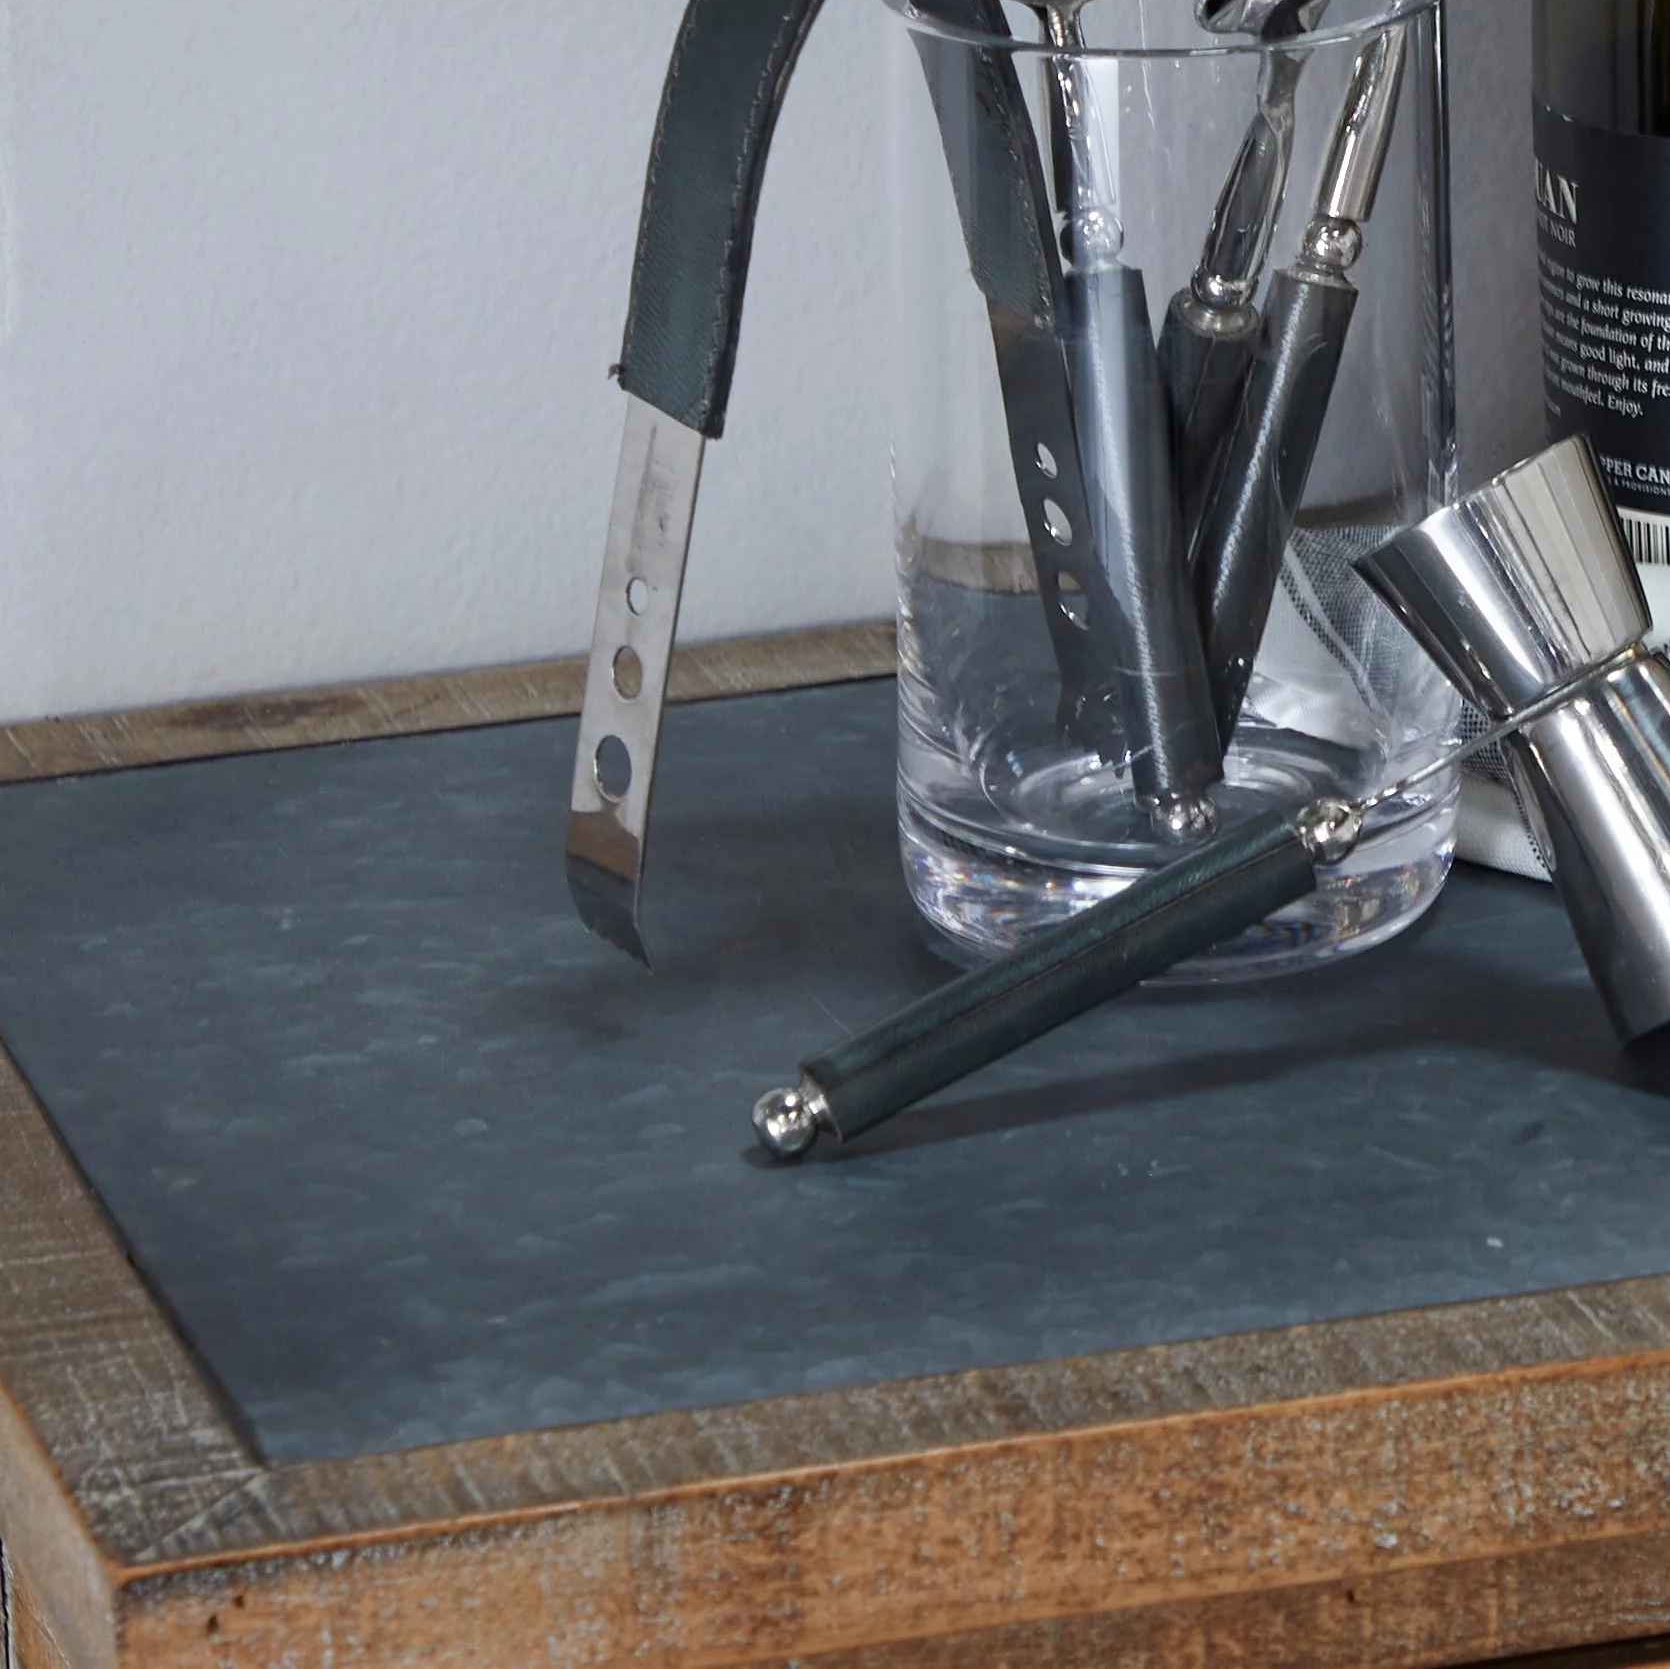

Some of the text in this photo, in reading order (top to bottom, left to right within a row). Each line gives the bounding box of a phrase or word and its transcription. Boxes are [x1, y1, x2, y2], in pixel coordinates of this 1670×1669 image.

[1549, 218, 1577, 248] NOIR
[1576, 273, 1601, 291] grow
[1602, 276, 1624, 299] this
[1582, 297, 1591, 312] a
[1591, 297, 1620, 320] short
[1580, 316, 1637, 347] foundation
[1640, 331, 1655, 354] of
[1579, 341, 1606, 361] good
[1608, 346, 1641, 371] light,
[1644, 355, 1670, 375] and
[1586, 364, 1630, 394] through
[1632, 376, 1649, 395] its
[1607, 393, 1645, 419] Enjoy.
